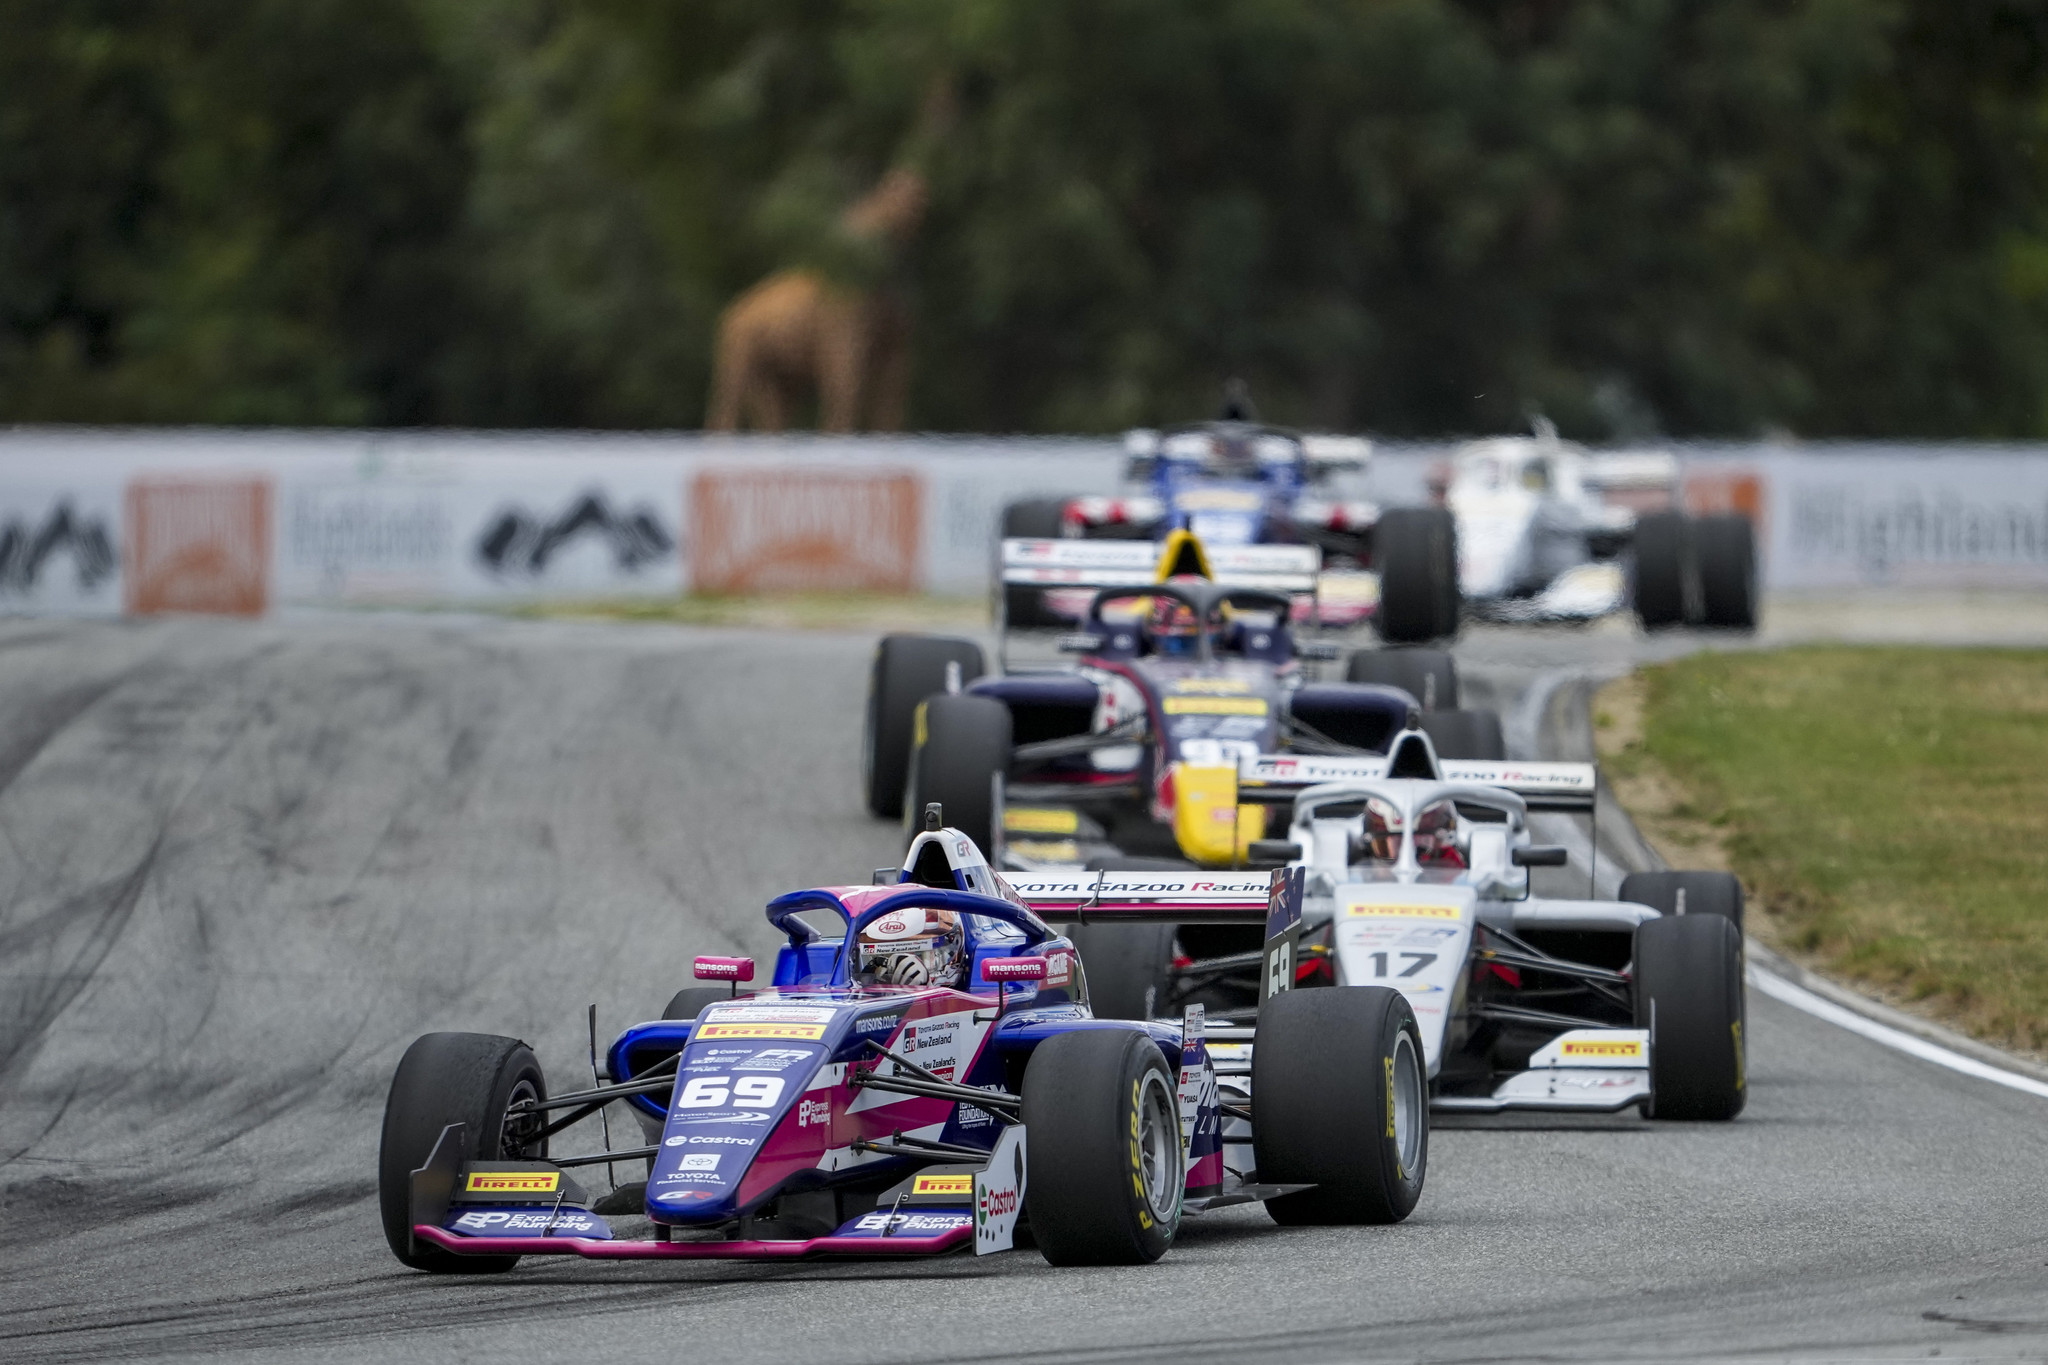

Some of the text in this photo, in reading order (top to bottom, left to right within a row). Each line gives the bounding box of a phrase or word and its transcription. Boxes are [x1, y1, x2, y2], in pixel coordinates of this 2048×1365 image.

[1307, 766, 1381, 777] TOYOT
[1502, 771, 1583, 785] Racing
[956, 840, 971, 857] GR
[1011, 883, 1079, 892] YOTA
[1086, 882, 1185, 892] GAZOO
[1354, 906, 1453, 917] PIRELLI
[695, 963, 738, 971] mansons
[989, 964, 1041, 972] mansons
[1268, 941, 1290, 999] 69
[1368, 952, 1438, 978] 17
[856, 1015, 898, 1034] mansons.co.nz
[945, 1021, 960, 1030] Racing
[704, 1026, 817, 1036] PIRELLI
[904, 1037, 916, 1052] GR
[917, 1033, 952, 1049] New Zealand
[1565, 1043, 1637, 1054] PIRELLI
[922, 1061, 932, 1069] New
[932, 1056, 956, 1069] Zealand's
[678, 1076, 786, 1109] 69
[811, 1101, 829, 1114] Express
[810, 1111, 831, 1126] Plumbing
[689, 1136, 756, 1146] Castrol
[667, 1172, 721, 1180] TOYOTA
[472, 1177, 553, 1188] PIRELLI
[918, 1180, 972, 1191] PIRE
[656, 1190, 714, 1200] GR
[988, 1185, 1017, 1217] Castrol
[510, 1214, 587, 1222] Express
[909, 1215, 973, 1225] Expres
[1139, 1210, 1153, 1230] P
[504, 1221, 594, 1231] Plumbing
[903, 1221, 970, 1229] Plumb
